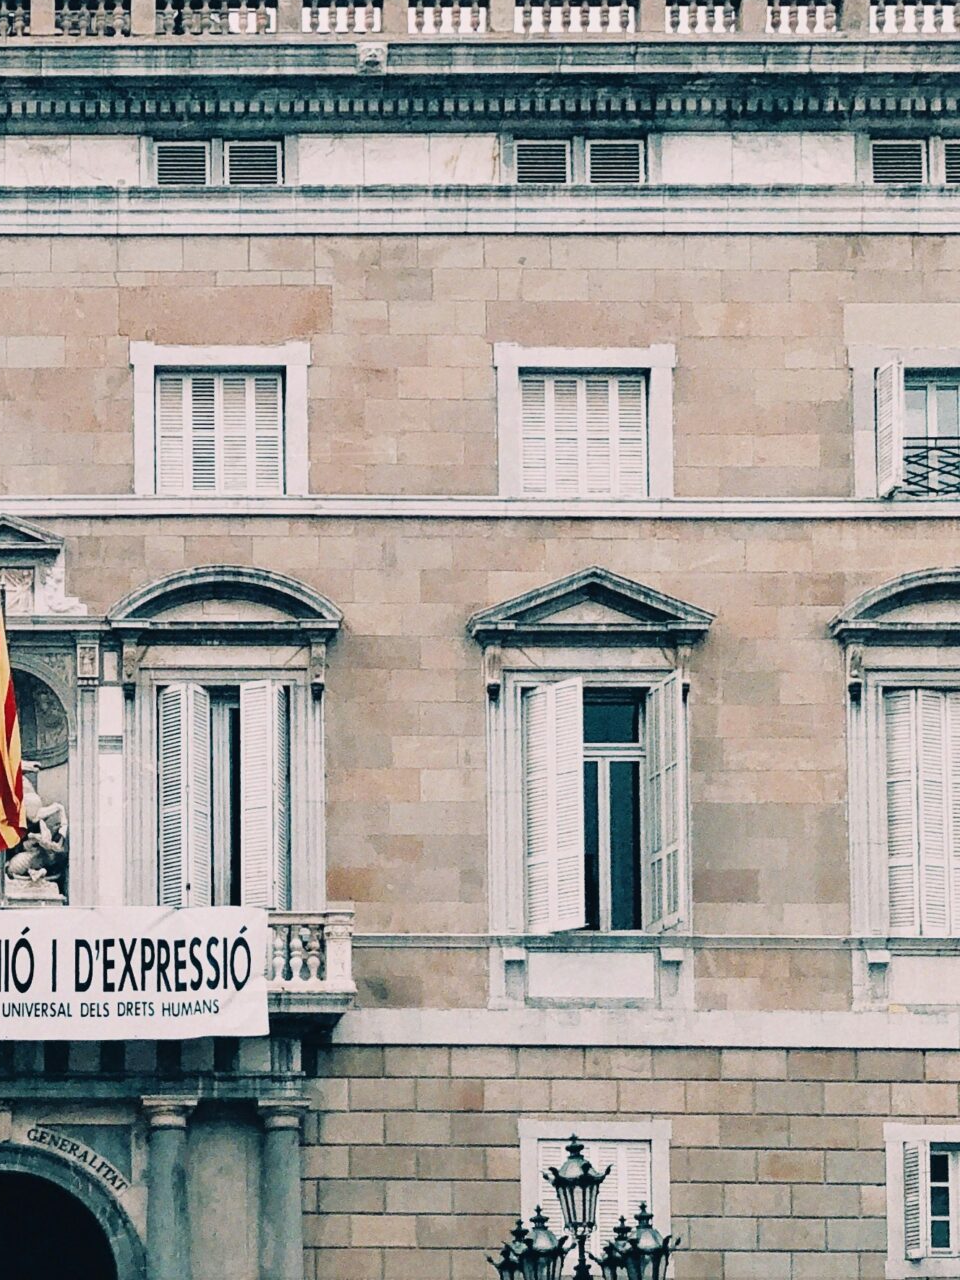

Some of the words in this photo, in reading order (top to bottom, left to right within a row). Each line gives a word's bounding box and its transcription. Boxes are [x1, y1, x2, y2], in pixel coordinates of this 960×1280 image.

[51, 938, 57, 993] I
[74, 925, 252, 993] D'EXPRESSIÓ
[2, 1002, 73, 1018] UNIVERSAL
[80, 1002, 110, 1018] DELS
[117, 1001, 155, 1017] DRETS
[161, 1000, 220, 1017] HUMANS
[26, 1128, 128, 1192] GENERALITAT
